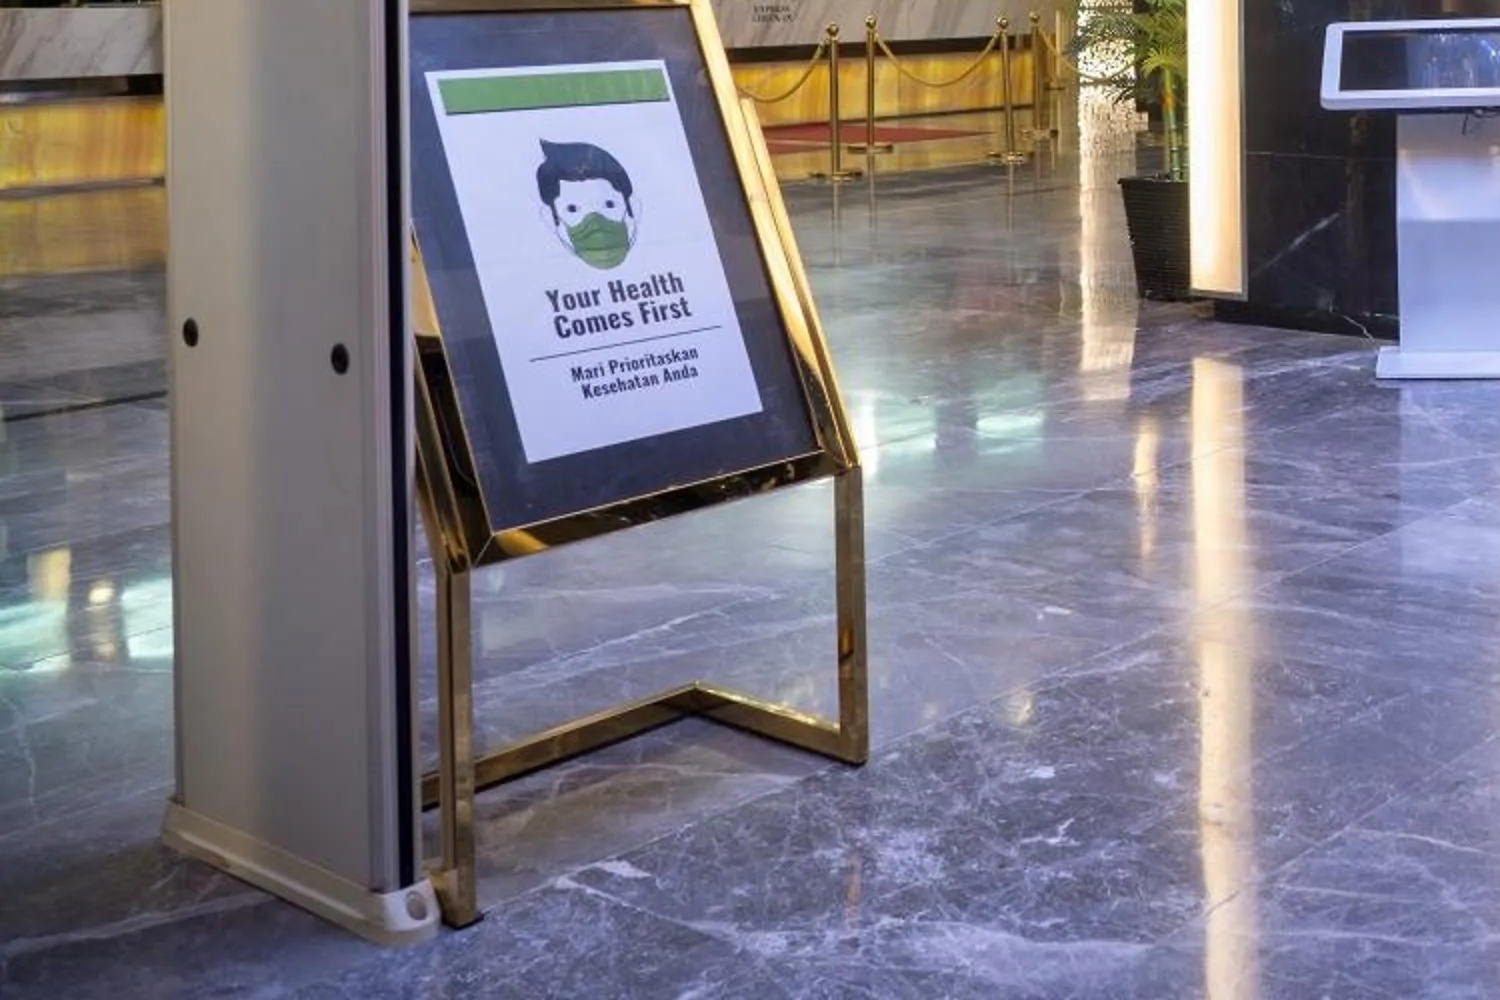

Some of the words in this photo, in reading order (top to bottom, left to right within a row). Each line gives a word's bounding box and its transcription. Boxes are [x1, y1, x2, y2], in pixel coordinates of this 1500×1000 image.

[545, 289, 600, 312] Your
[608, 272, 684, 303] Health
[554, 311, 634, 338] Comes
[638, 297, 692, 324] First
[571, 361, 605, 382] Mari
[608, 348, 699, 374] Prioritaskan
[581, 374, 660, 399] Kesehatan
[663, 365, 698, 382] Anda
